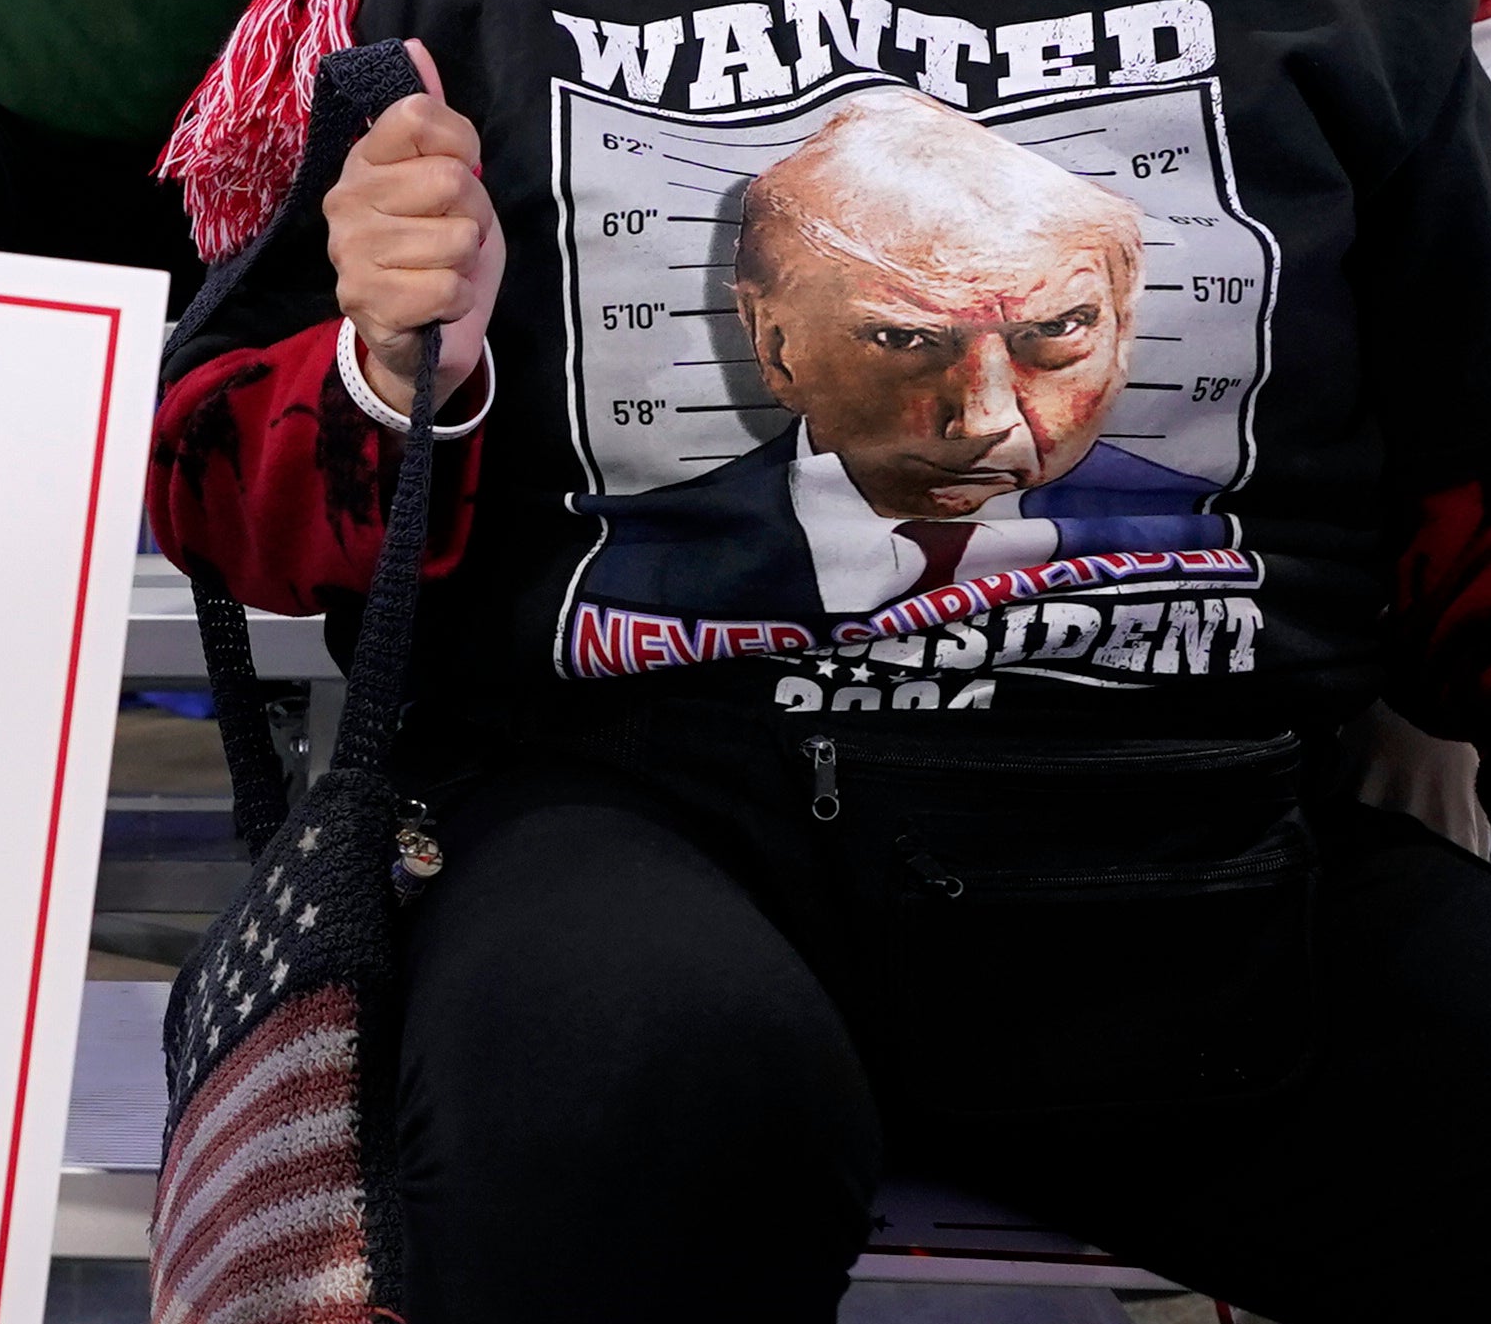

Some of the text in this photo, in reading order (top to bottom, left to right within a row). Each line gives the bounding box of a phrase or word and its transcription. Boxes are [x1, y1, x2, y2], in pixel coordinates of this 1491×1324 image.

[602, 133, 653, 155] 6'2"
[1131, 146, 1190, 179] 6'2"
[602, 209, 658, 237] 6'0"
[1192, 276, 1255, 304] 5'10"
[602, 302, 665, 331] 5'10"
[1191, 376, 1242, 403] 5'8"
[612, 399, 666, 426] 5'8"
